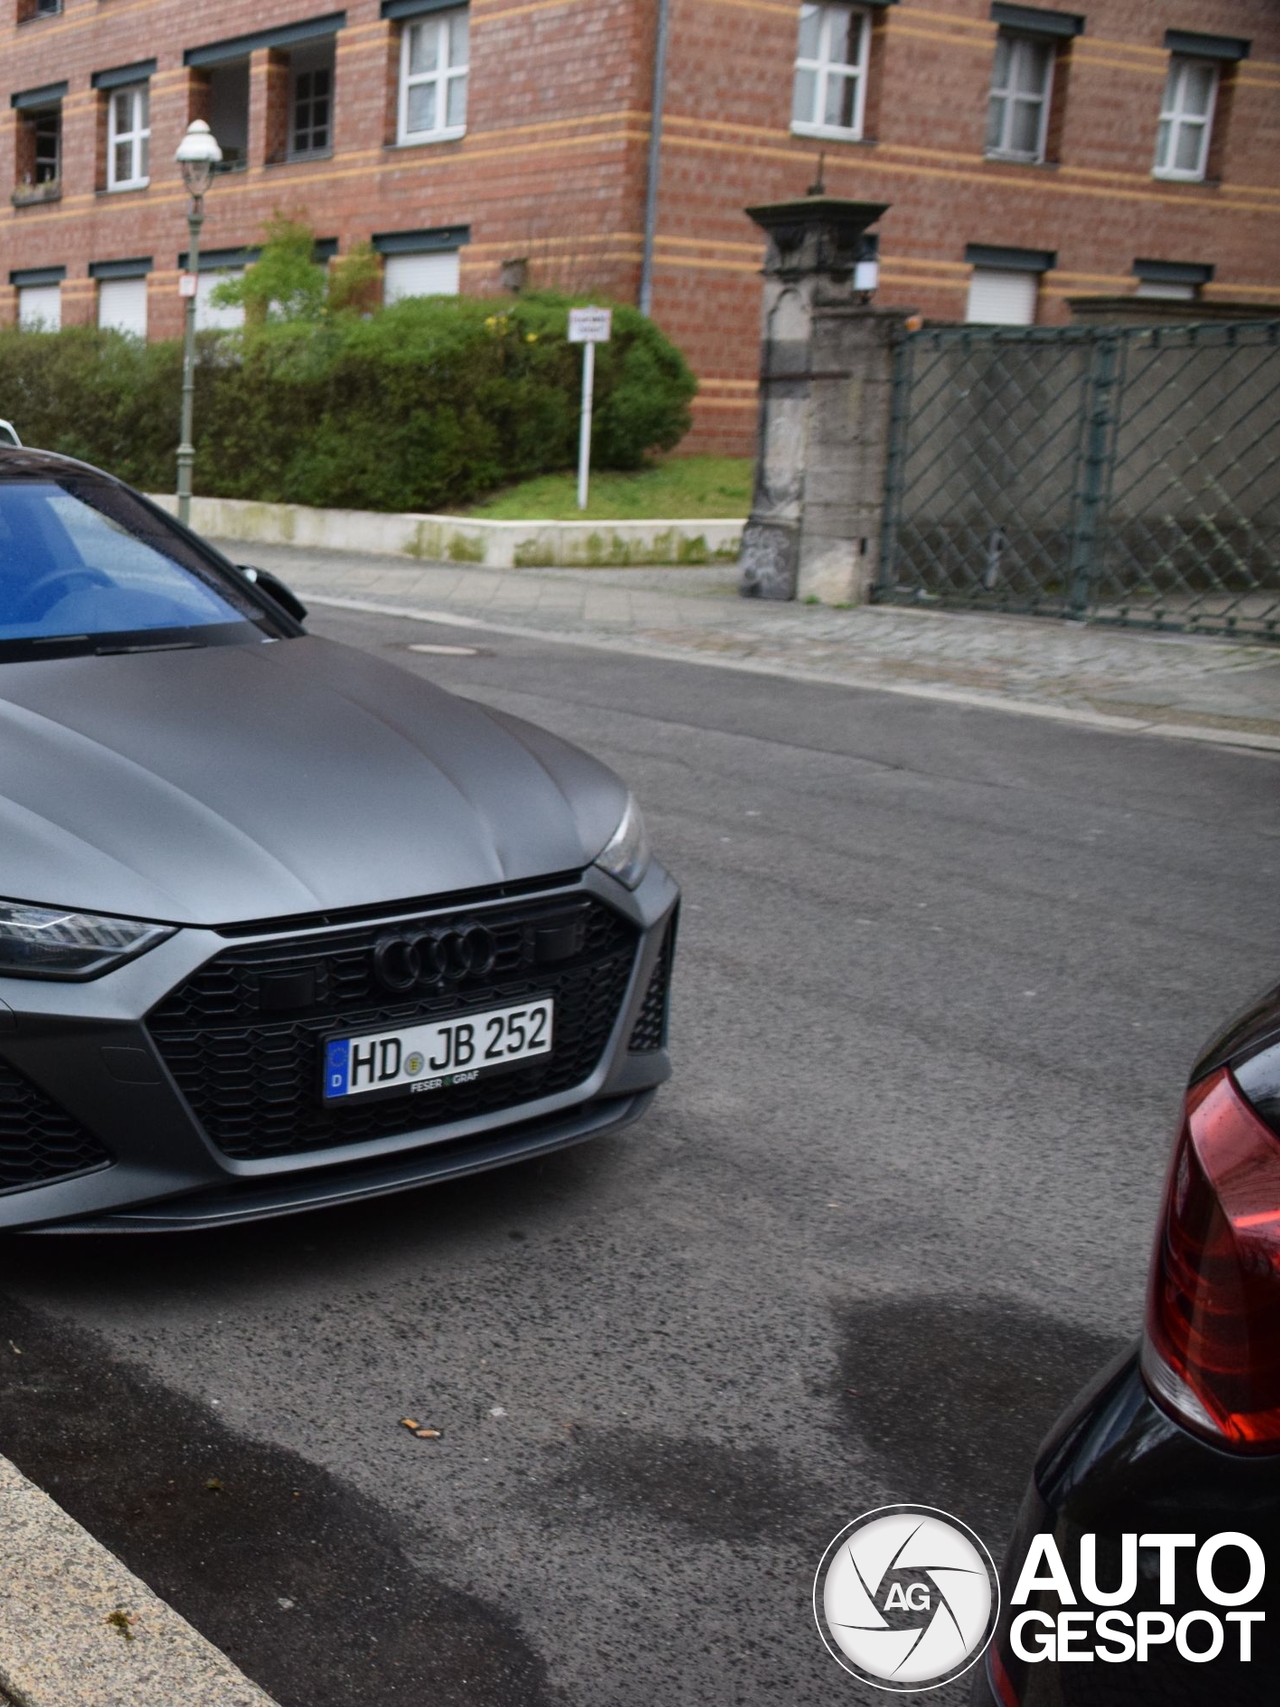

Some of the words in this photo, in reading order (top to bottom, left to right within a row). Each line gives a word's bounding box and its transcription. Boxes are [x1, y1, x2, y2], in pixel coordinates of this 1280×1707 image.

[351, 1037, 402, 1087] HD
[429, 1023, 475, 1072] JB
[484, 1007, 547, 1060] 252
[332, 1076, 341, 1087] D
[410, 1078, 442, 1093] FESER
[452, 1070, 479, 1084] GRAF
